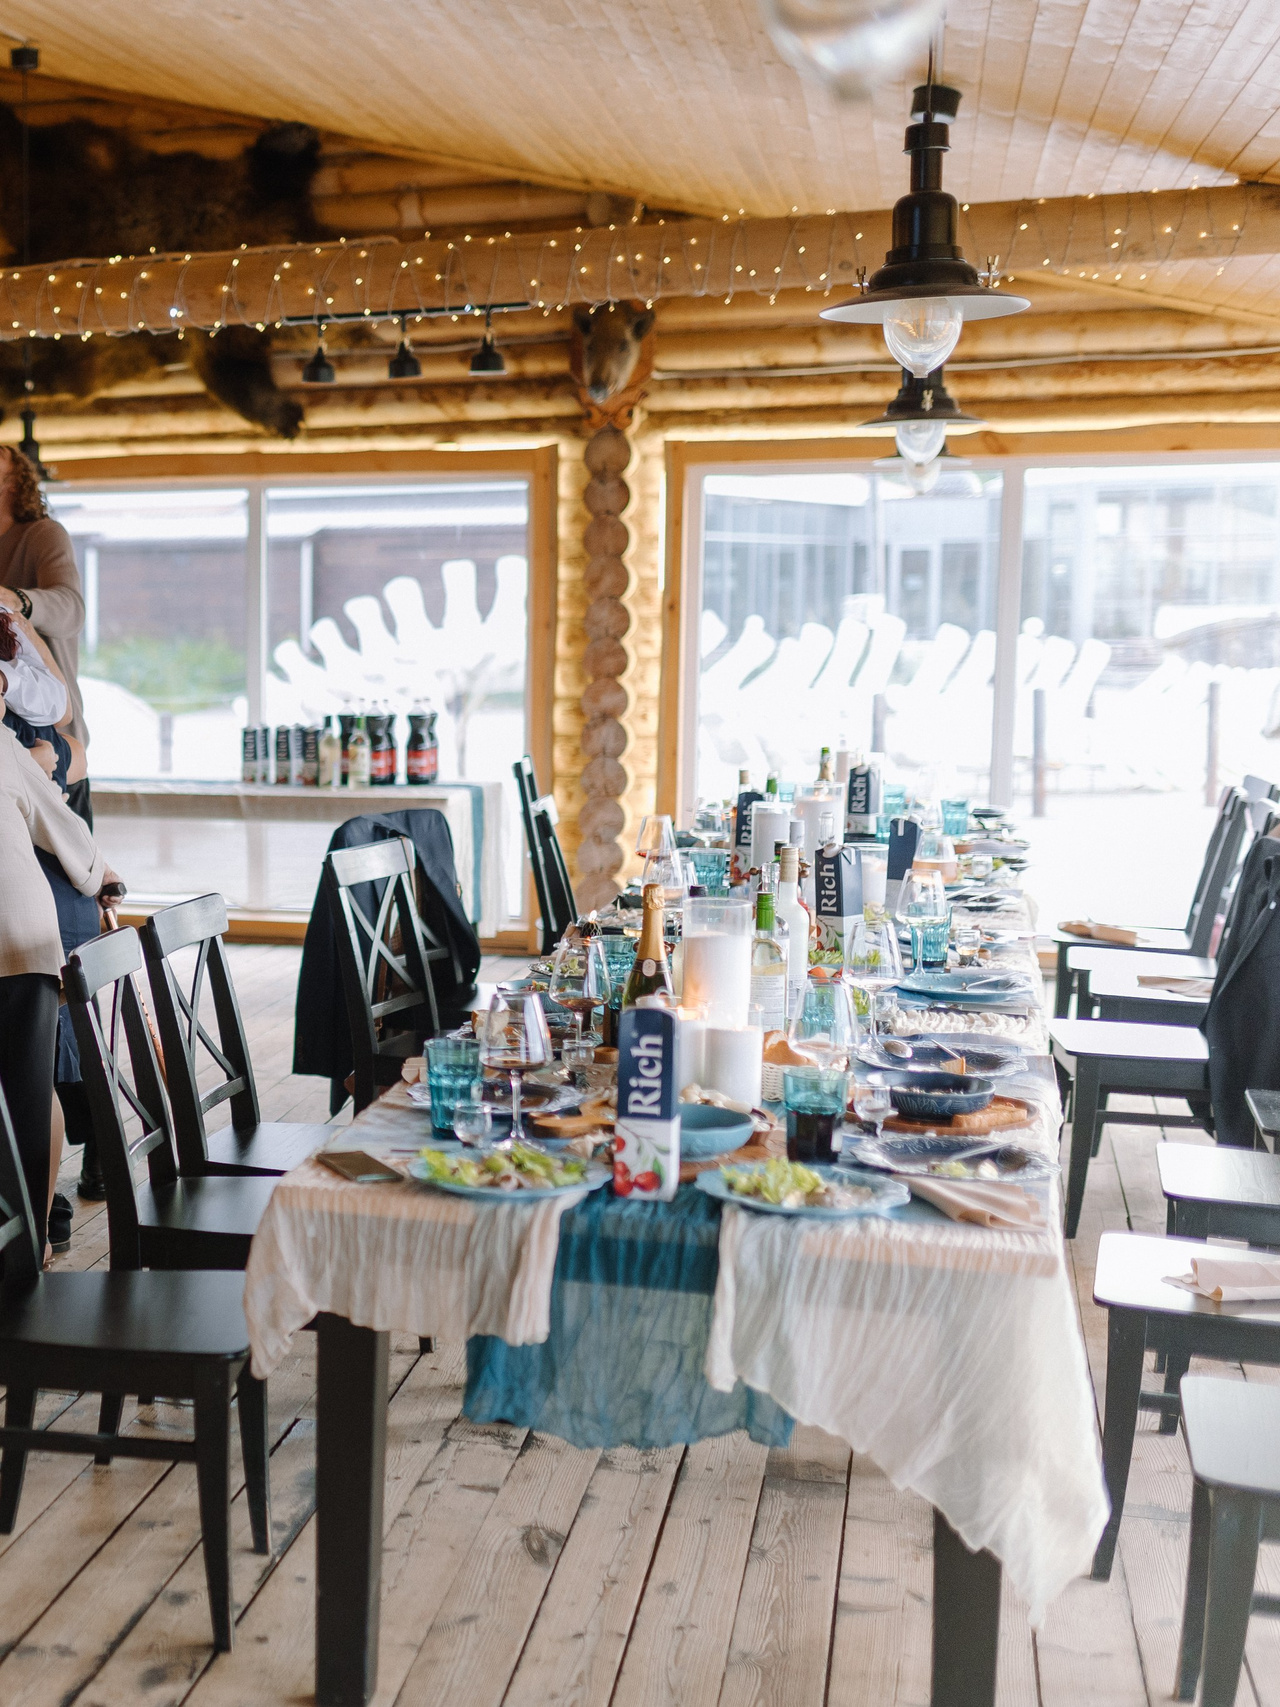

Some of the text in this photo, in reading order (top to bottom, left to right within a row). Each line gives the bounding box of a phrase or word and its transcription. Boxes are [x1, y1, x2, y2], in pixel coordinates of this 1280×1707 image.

[852, 777, 867, 812] Rich
[820, 864, 837, 912] Rich
[628, 1034, 663, 1116] Rich
